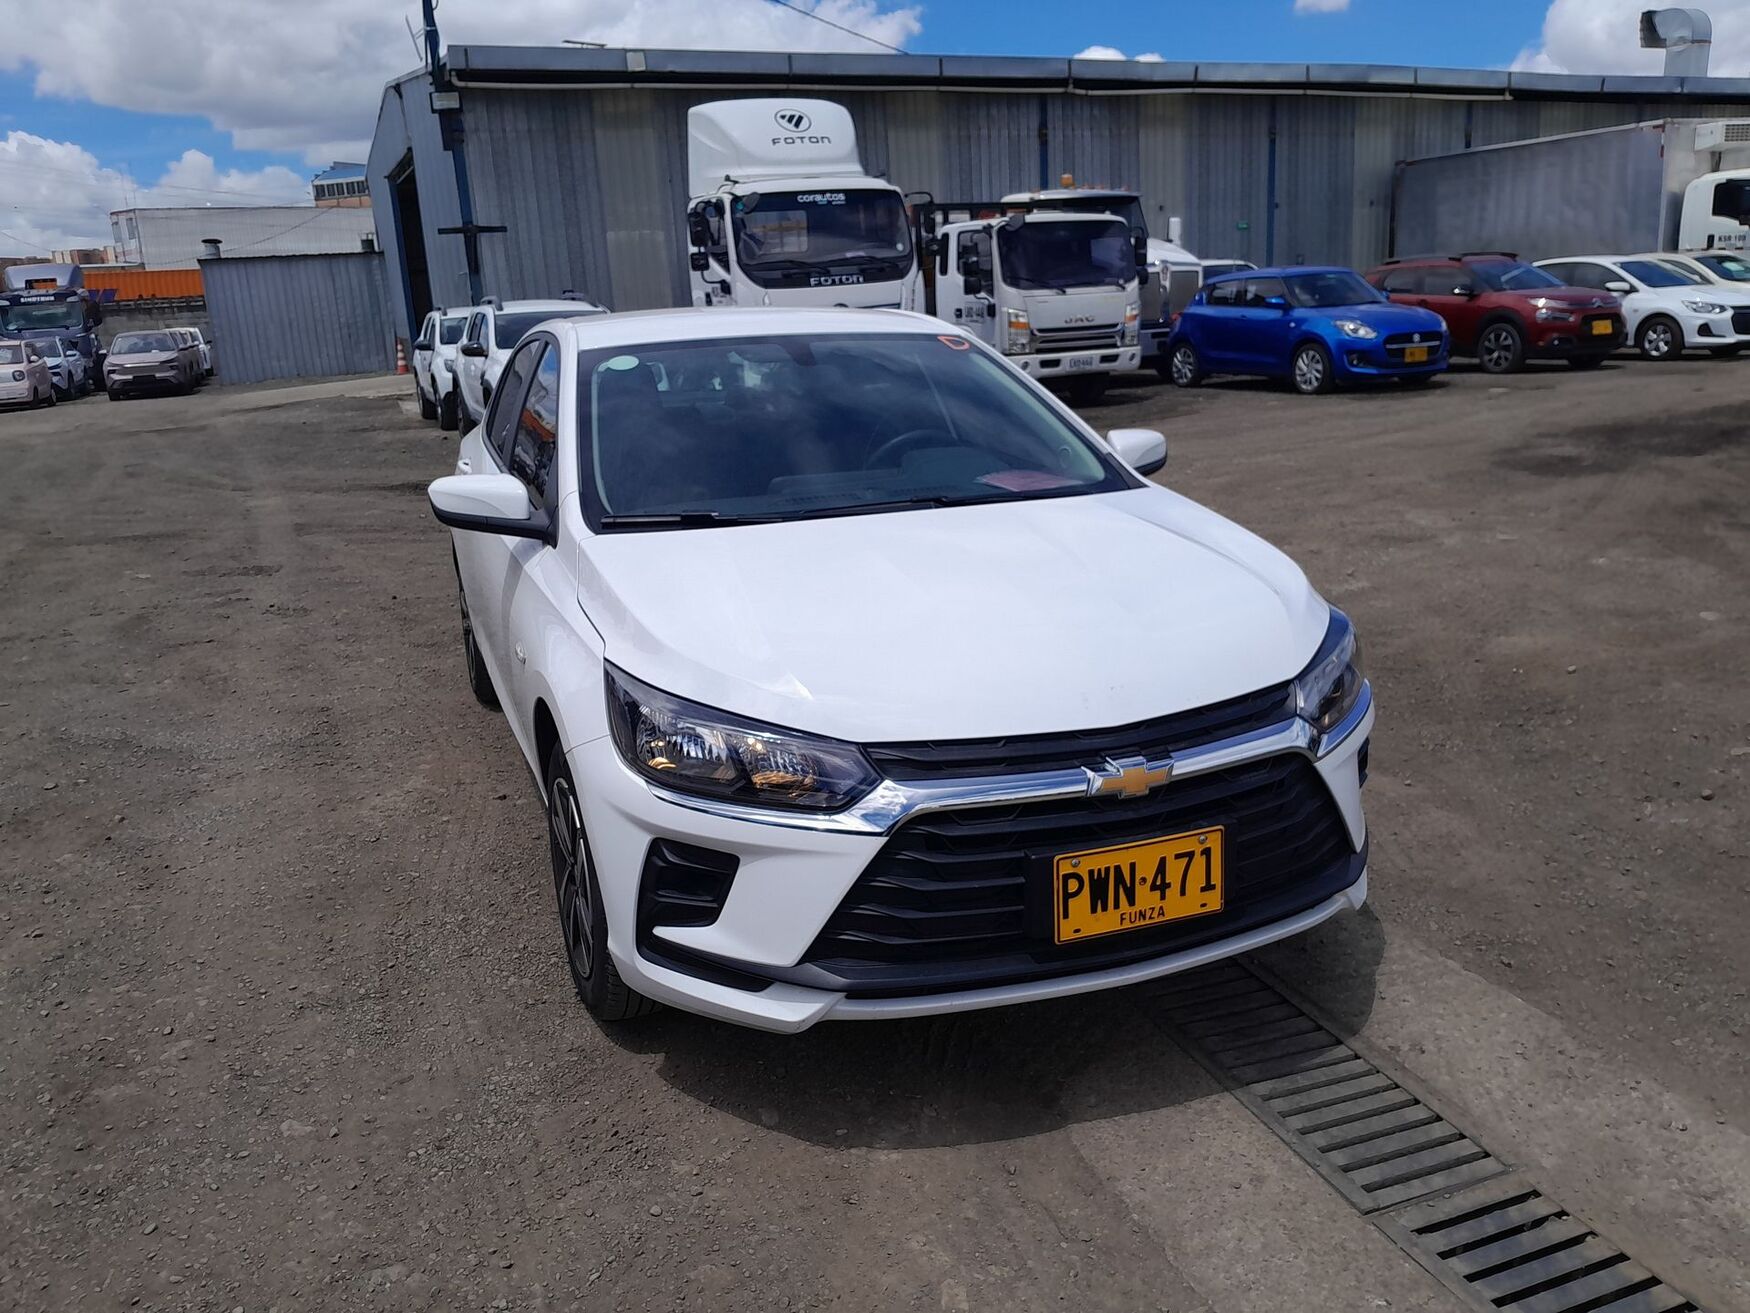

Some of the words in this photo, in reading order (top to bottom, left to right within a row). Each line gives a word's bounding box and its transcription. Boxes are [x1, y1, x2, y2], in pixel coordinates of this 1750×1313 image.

[771, 136, 832, 146] FOTON
[810, 274, 864, 287] FOTON
[1064, 314, 1096, 324] JAC
[1119, 905, 1166, 926] FUNZA
